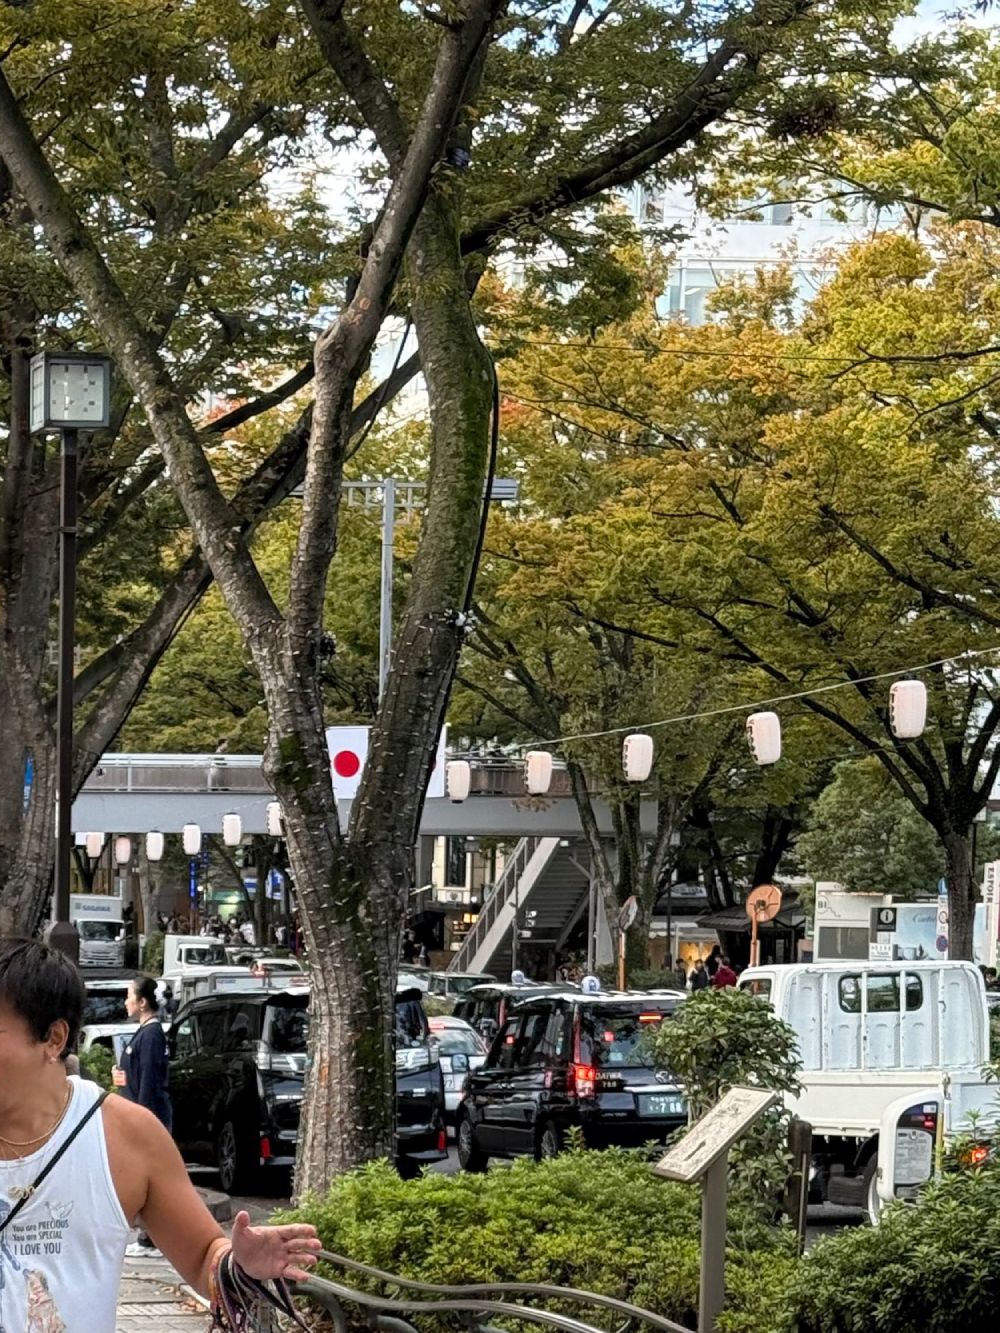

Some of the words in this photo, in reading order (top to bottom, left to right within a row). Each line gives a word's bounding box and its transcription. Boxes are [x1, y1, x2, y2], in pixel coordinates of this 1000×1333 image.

[38, 1219, 69, 1230] PRECIOUS
[38, 1230, 62, 1240] SPECIAL
[20, 1243, 41, 1255] LOVE
[43, 1242, 61, 1254] YOU
